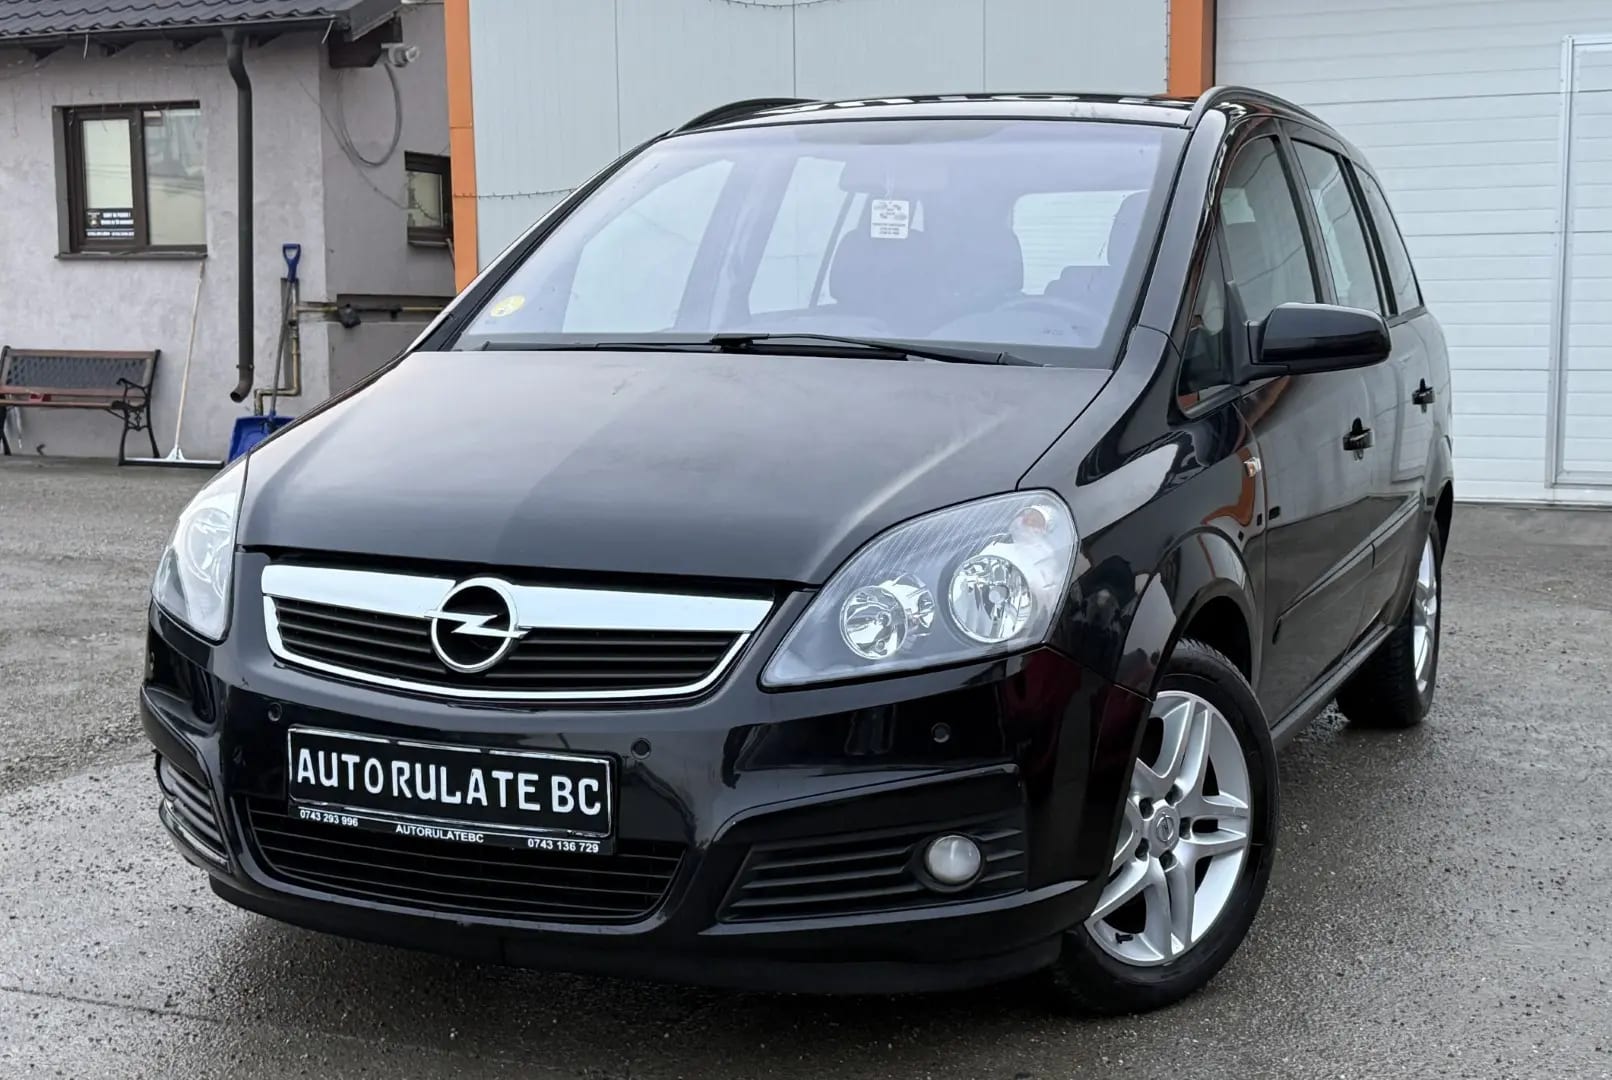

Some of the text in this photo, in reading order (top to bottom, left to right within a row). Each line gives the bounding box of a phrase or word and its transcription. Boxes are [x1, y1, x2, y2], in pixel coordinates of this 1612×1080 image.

[299, 809, 321, 822] 0743
[323, 813, 339, 825] 293
[395, 824, 485, 844] AUTORULATEBC
[527, 838, 600, 854] 0743 136 729
